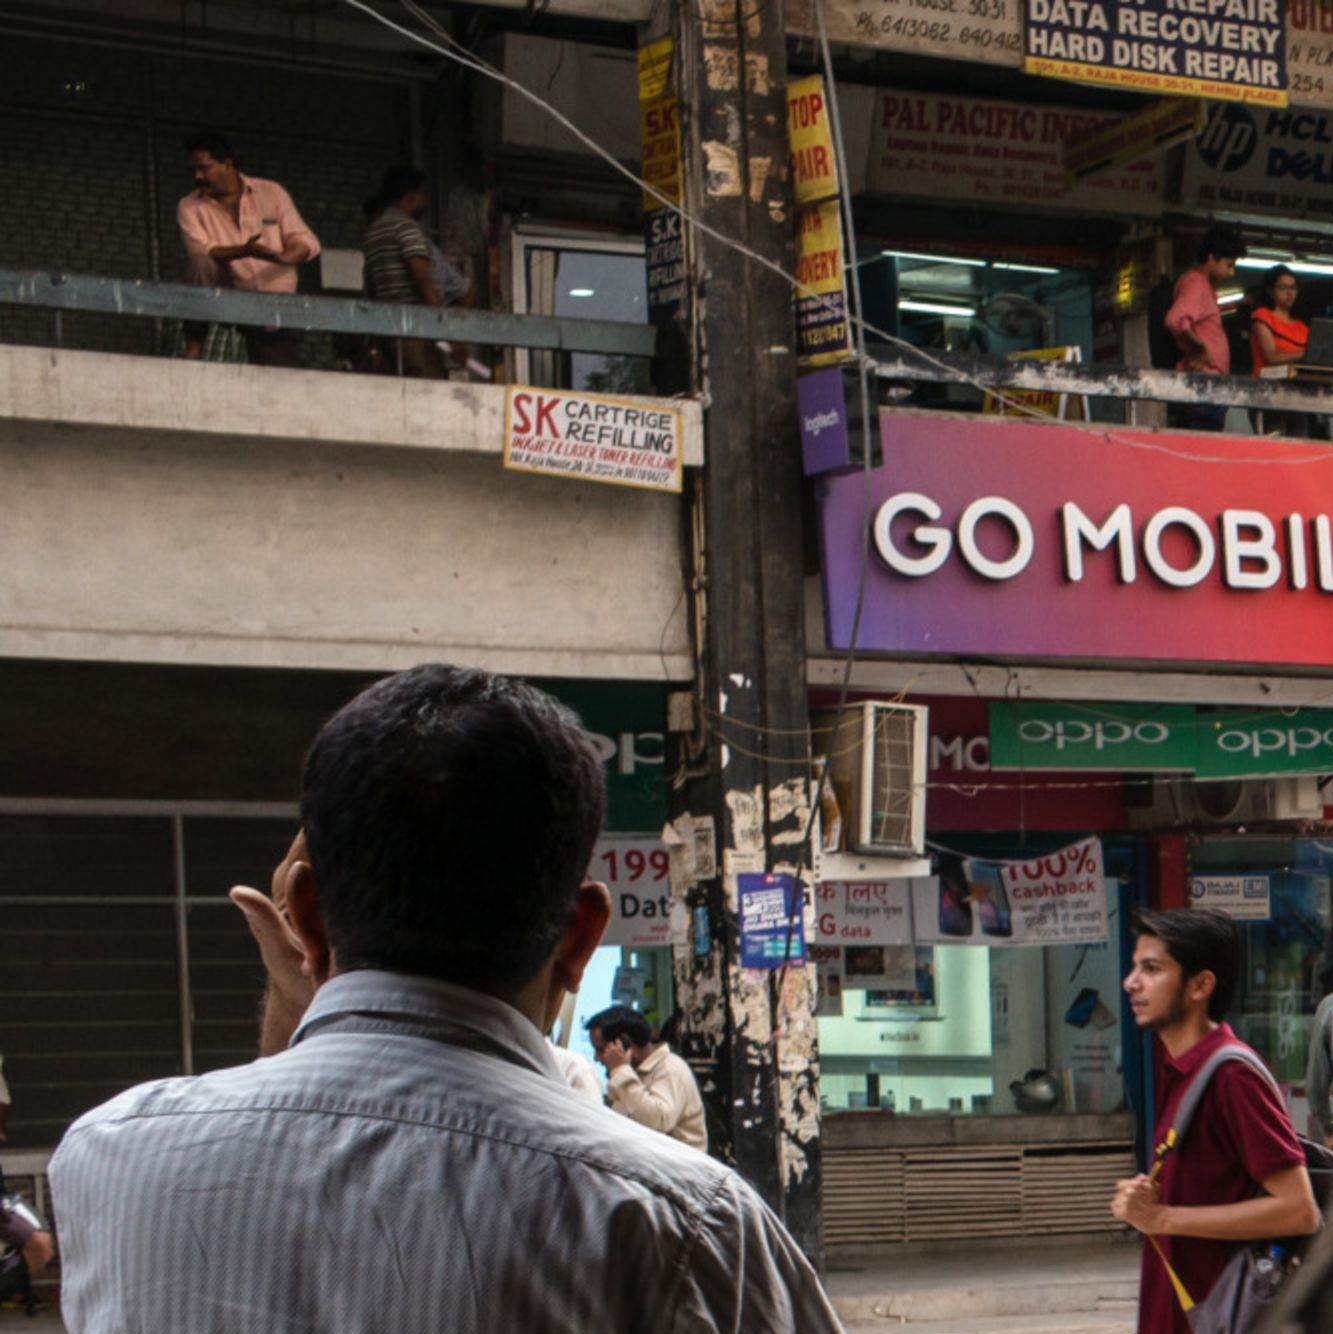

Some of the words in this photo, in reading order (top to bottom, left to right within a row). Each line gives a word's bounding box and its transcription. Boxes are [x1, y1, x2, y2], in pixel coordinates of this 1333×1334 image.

[1029, 0, 1110, 31] DATA
[1118, 8, 1282, 54] RECOVERY
[1029, 30, 1105, 63] HARD
[1112, 39, 1177, 72] DISK
[1185, 50, 1281, 88] REPAIR
[1086, 67, 1117, 81] RAJA
[1119, 72, 1161, 86] HOUSE
[1242, 88, 1281, 103] PLACE
[881, 97, 931, 132] PAL
[936, 101, 1037, 142] PACIFIC
[1265, 111, 1333, 143] HCL
[513, 393, 561, 439] SK
[565, 400, 672, 431] CARTRIGE
[804, 409, 839, 437] logitech
[565, 421, 673, 455] REFILLING
[875, 492, 1034, 580] GO
[1018, 719, 1170, 751] oppo
[601, 850, 669, 880] 199
[1012, 877, 1097, 902] cashback
[841, 923, 872, 938] data
